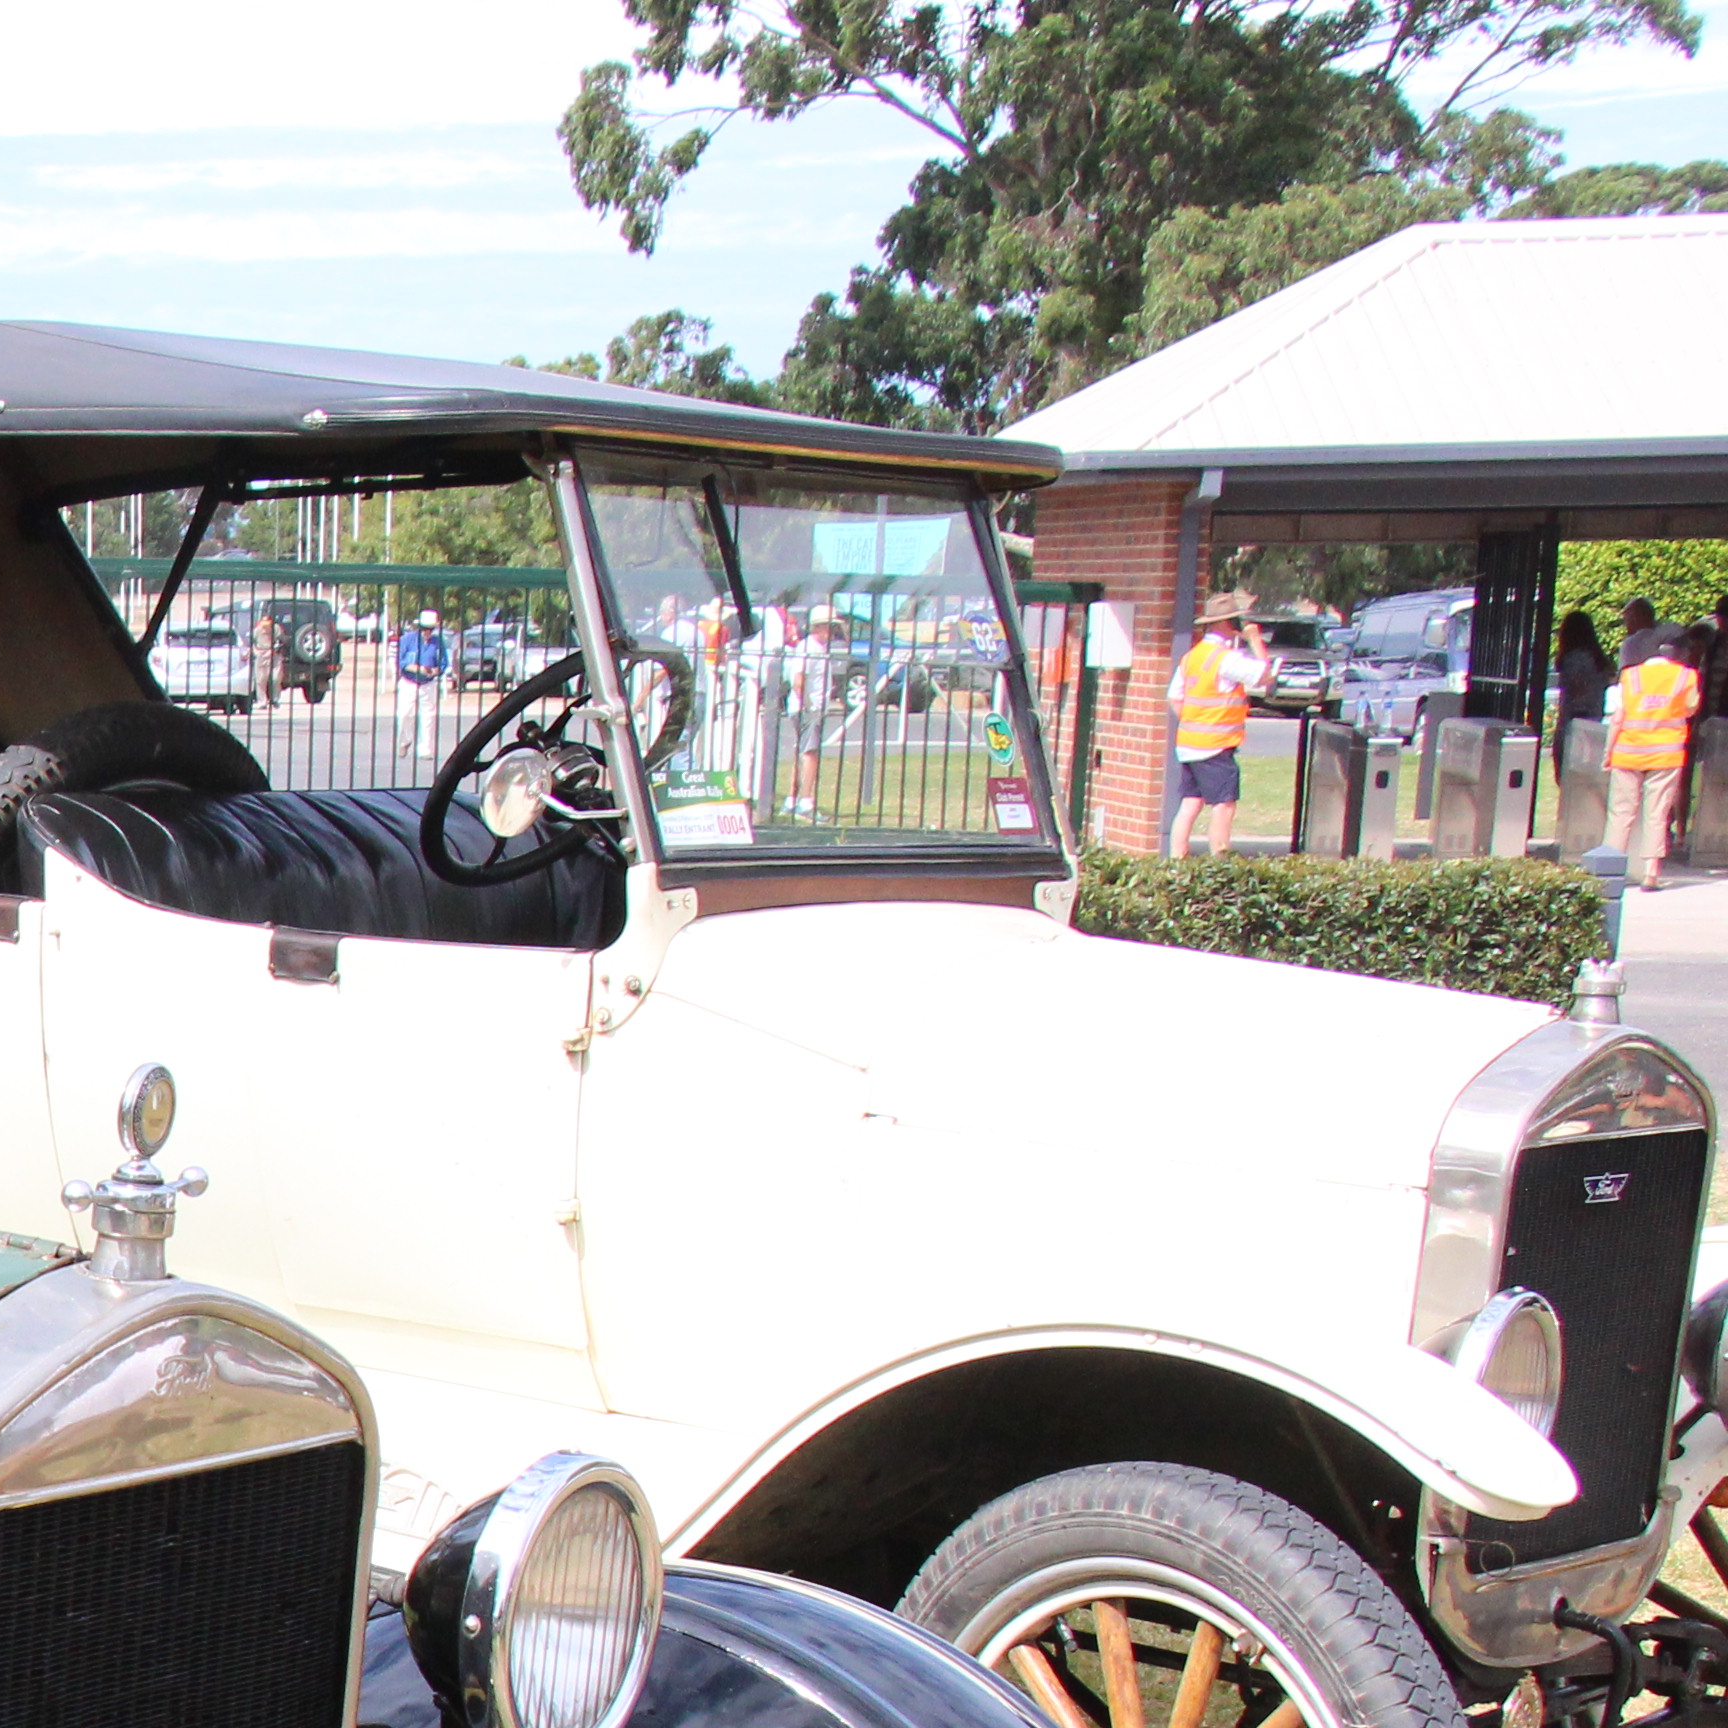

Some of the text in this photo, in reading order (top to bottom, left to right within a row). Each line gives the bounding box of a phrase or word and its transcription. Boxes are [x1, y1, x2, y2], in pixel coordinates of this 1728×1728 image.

[971, 622, 998, 652] 62
[681, 771, 705, 783] Great
[667, 785, 706, 798] Australian
[717, 815, 746, 835] 0004
